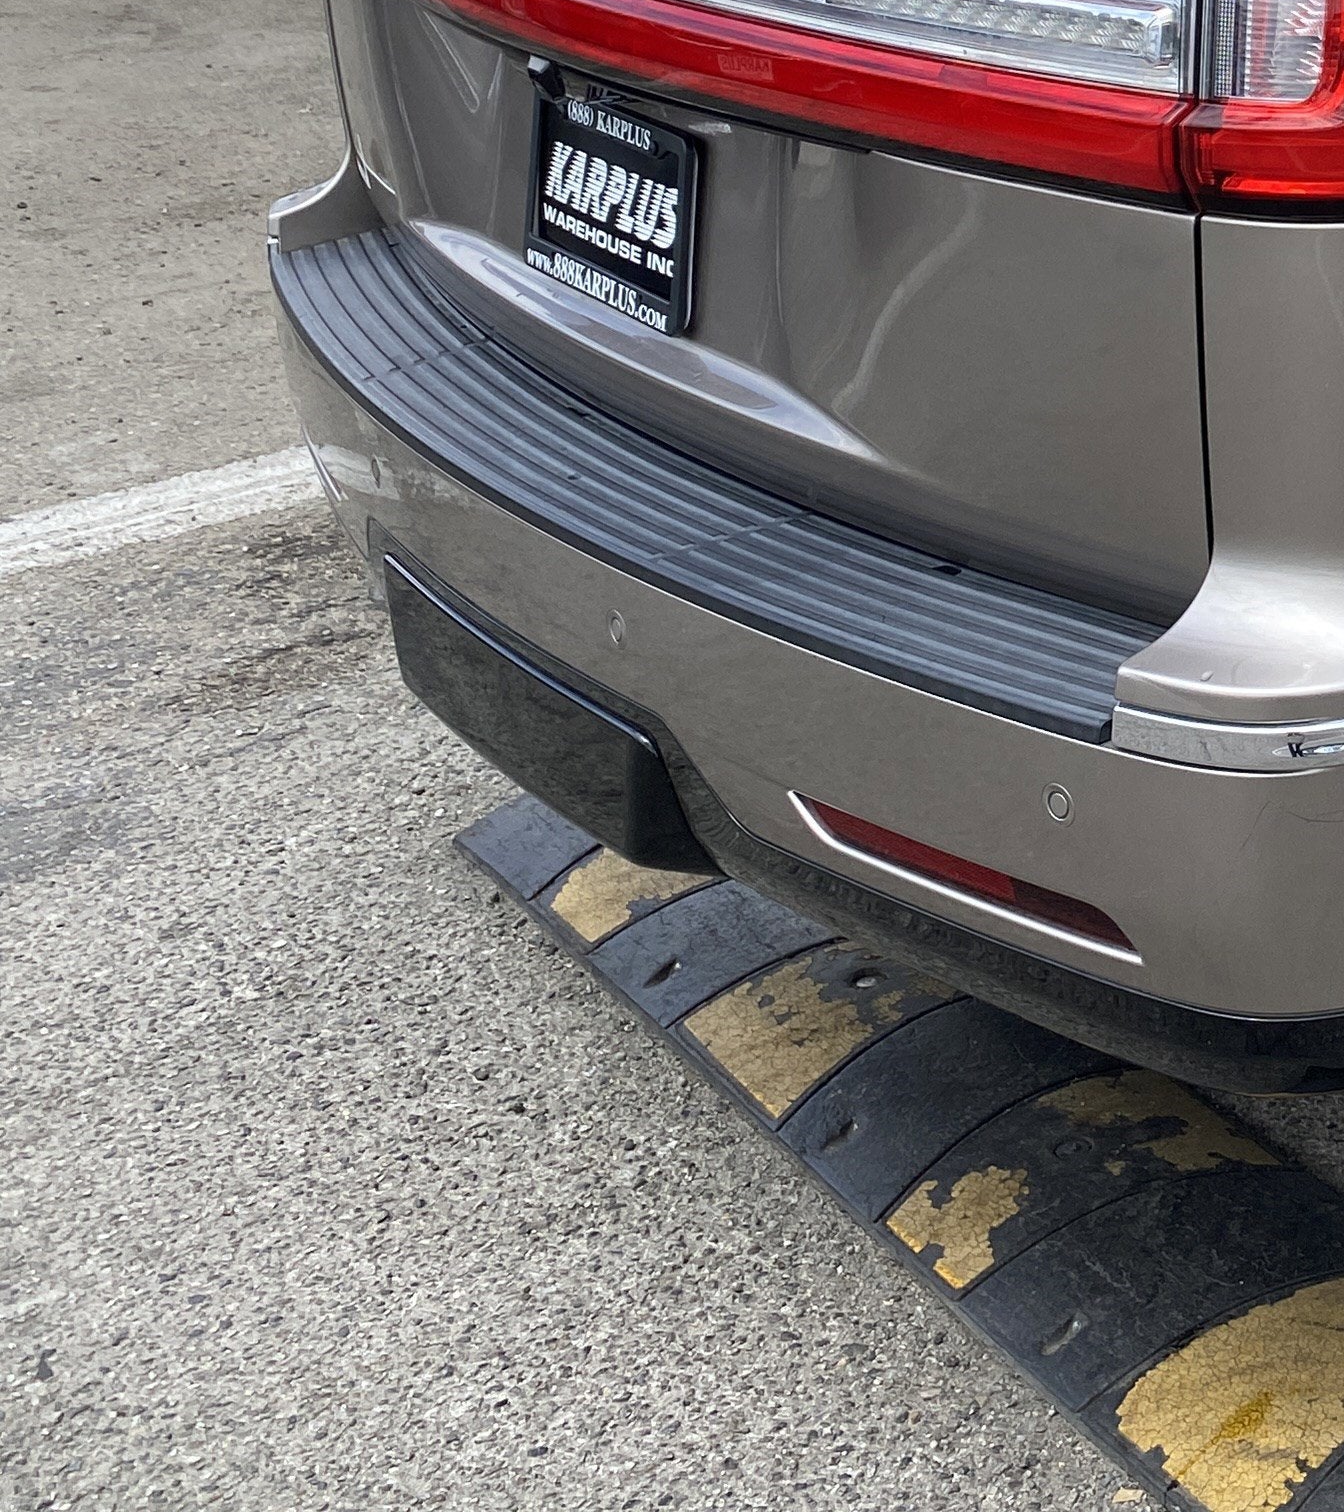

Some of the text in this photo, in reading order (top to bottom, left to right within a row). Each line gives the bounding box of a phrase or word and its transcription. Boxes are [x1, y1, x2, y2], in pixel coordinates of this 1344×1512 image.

[567, 99, 651, 151] (888) KARPLUS
[544, 140, 679, 249] KARPLUS
[542, 202, 642, 265] WAREHOUSE
